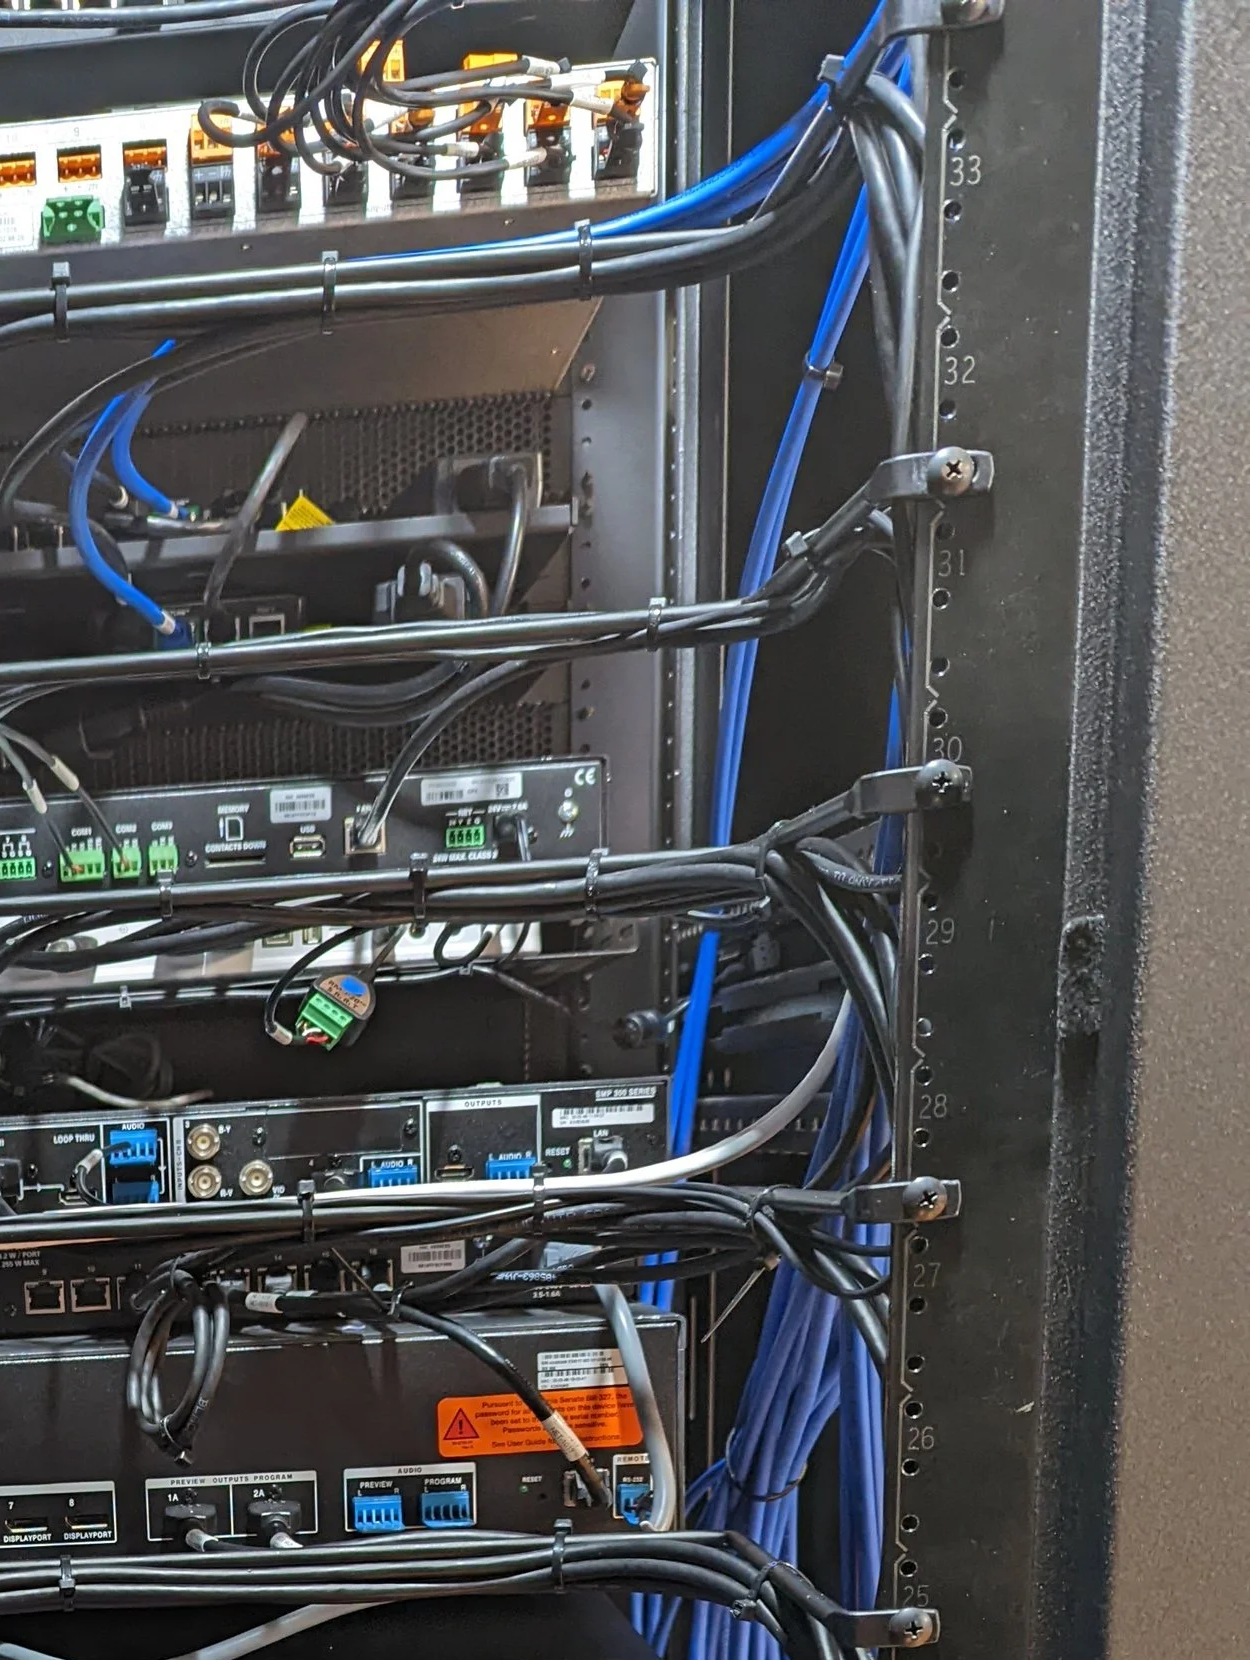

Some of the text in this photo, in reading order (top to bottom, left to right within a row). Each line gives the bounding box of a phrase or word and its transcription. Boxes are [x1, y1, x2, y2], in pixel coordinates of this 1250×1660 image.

[949, 156, 982, 186] 33
[945, 357, 976, 385] 32
[925, 920, 955, 946] 29
[919, 1097, 947, 1118] 28
[121, 1122, 145, 1130] AUDIO
[53, 1133, 95, 1144] LOOP THRU
[914, 1264, 941, 1287] 27
[909, 1429, 935, 1451] 26
[170, 1478, 205, 1486] PREVIEW
[253, 1473, 293, 1482] PROGRAM
[425, 1477, 462, 1486] PROGRAM
[360, 1481, 392, 1490] PREVIEW
[167, 1493, 179, 1502] 1A
[253, 1489, 265, 1498] 2A
[8, 1501, 14, 1510] 7
[3, 1533, 51, 1542] DISPLAYPORT
[64, 1531, 111, 1540] DISPLAYPORT
